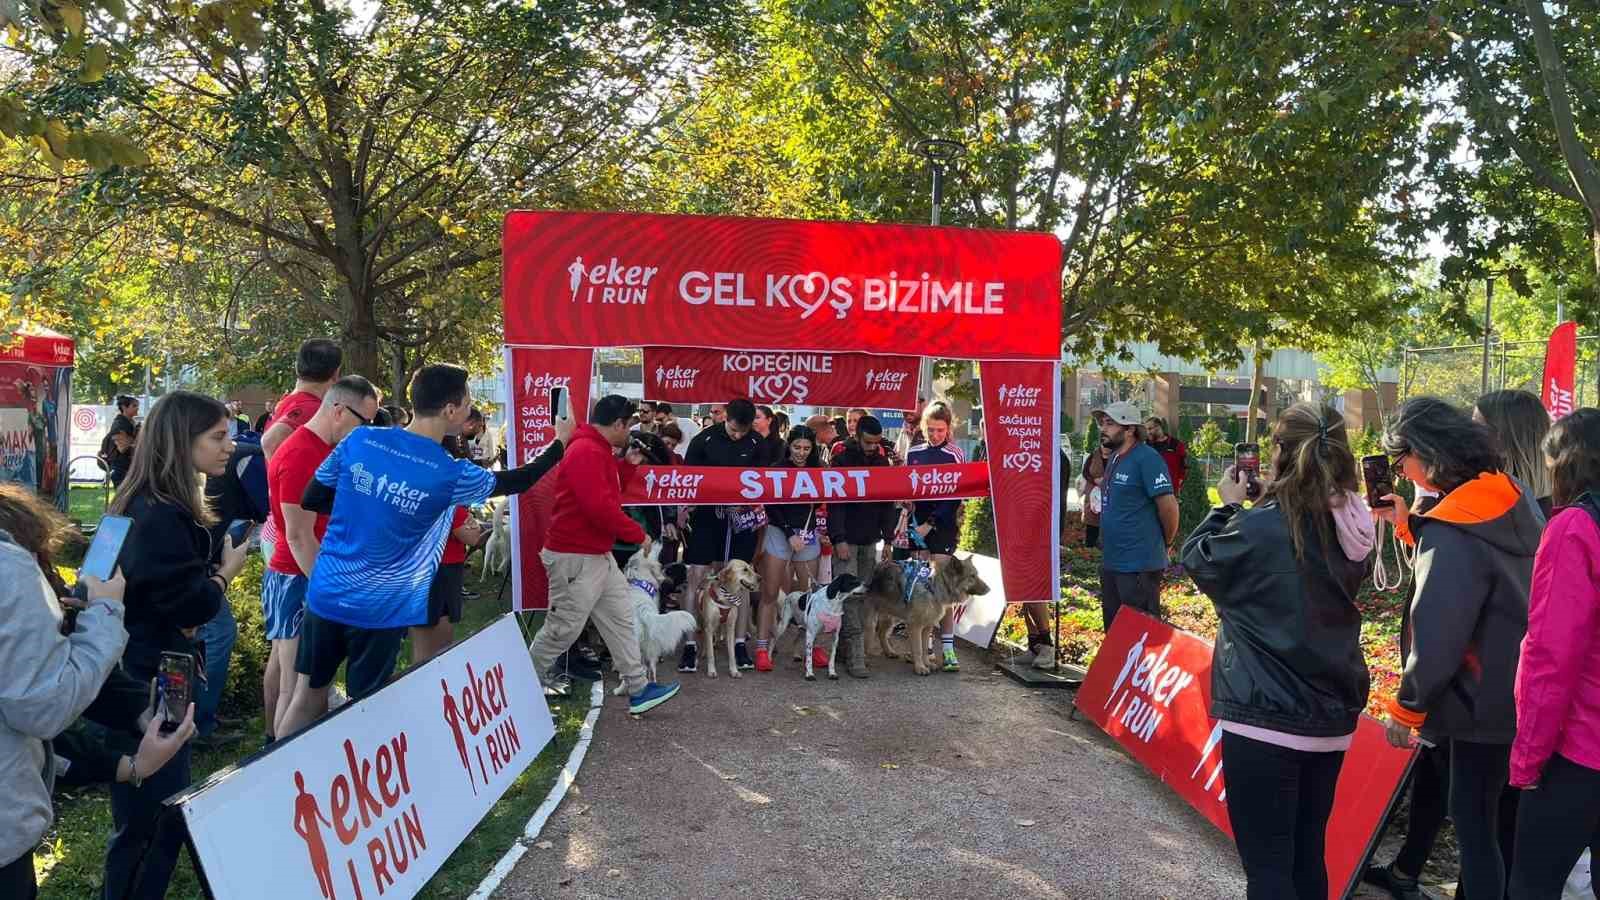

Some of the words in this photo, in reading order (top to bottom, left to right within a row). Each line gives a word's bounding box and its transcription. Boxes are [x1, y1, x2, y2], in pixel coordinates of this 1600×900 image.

[589, 257, 658, 286] eker
[587, 287, 593, 303] I
[602, 287, 648, 304] RUN
[679, 270, 756, 306] GEL
[766, 271, 853, 320] KOŞ
[863, 270, 1005, 315] BİZİMLE
[534, 372, 571, 387] eker
[666, 365, 700, 379] eker
[875, 368, 908, 382] eker
[665, 380, 669, 389] I
[672, 379, 694, 389] RUN
[748, 373, 808, 404] KOŞ
[872, 382, 877, 391] I
[879, 382, 902, 391] RUN
[1008, 384, 1042, 398] eker
[522, 405, 551, 416] SAĞL
[1006, 398, 1011, 407] I
[1014, 398, 1037, 407] RUN
[1558, 389, 1572, 417] UN
[522, 419, 551, 431] YAŞA
[999, 414, 1042, 425] SAĞLIKLI
[523, 431, 544, 444] İÇİN
[1007, 427, 1041, 438] YAŞAM
[1019, 438, 1041, 451] İÇİN
[1003, 451, 1042, 472] KOŞ
[658, 468, 704, 488] eker
[739, 469, 871, 500] START
[921, 468, 962, 485] eker
[387, 480, 429, 501] eker
[657, 488, 663, 499] I
[666, 487, 697, 499] RUN
[921, 485, 926, 496] I
[930, 485, 957, 496] RUN
[391, 496, 420, 511] RUN
[1131, 642, 1194, 708] eker
[463, 662, 508, 736] eker
[1112, 689, 1129, 717] I
[1120, 695, 1164, 743] RUN
[476, 745, 489, 784] I
[485, 715, 521, 774] RUN
[331, 731, 410, 845] eker
[347, 858, 363, 900] I
[367, 803, 427, 896] RUN
